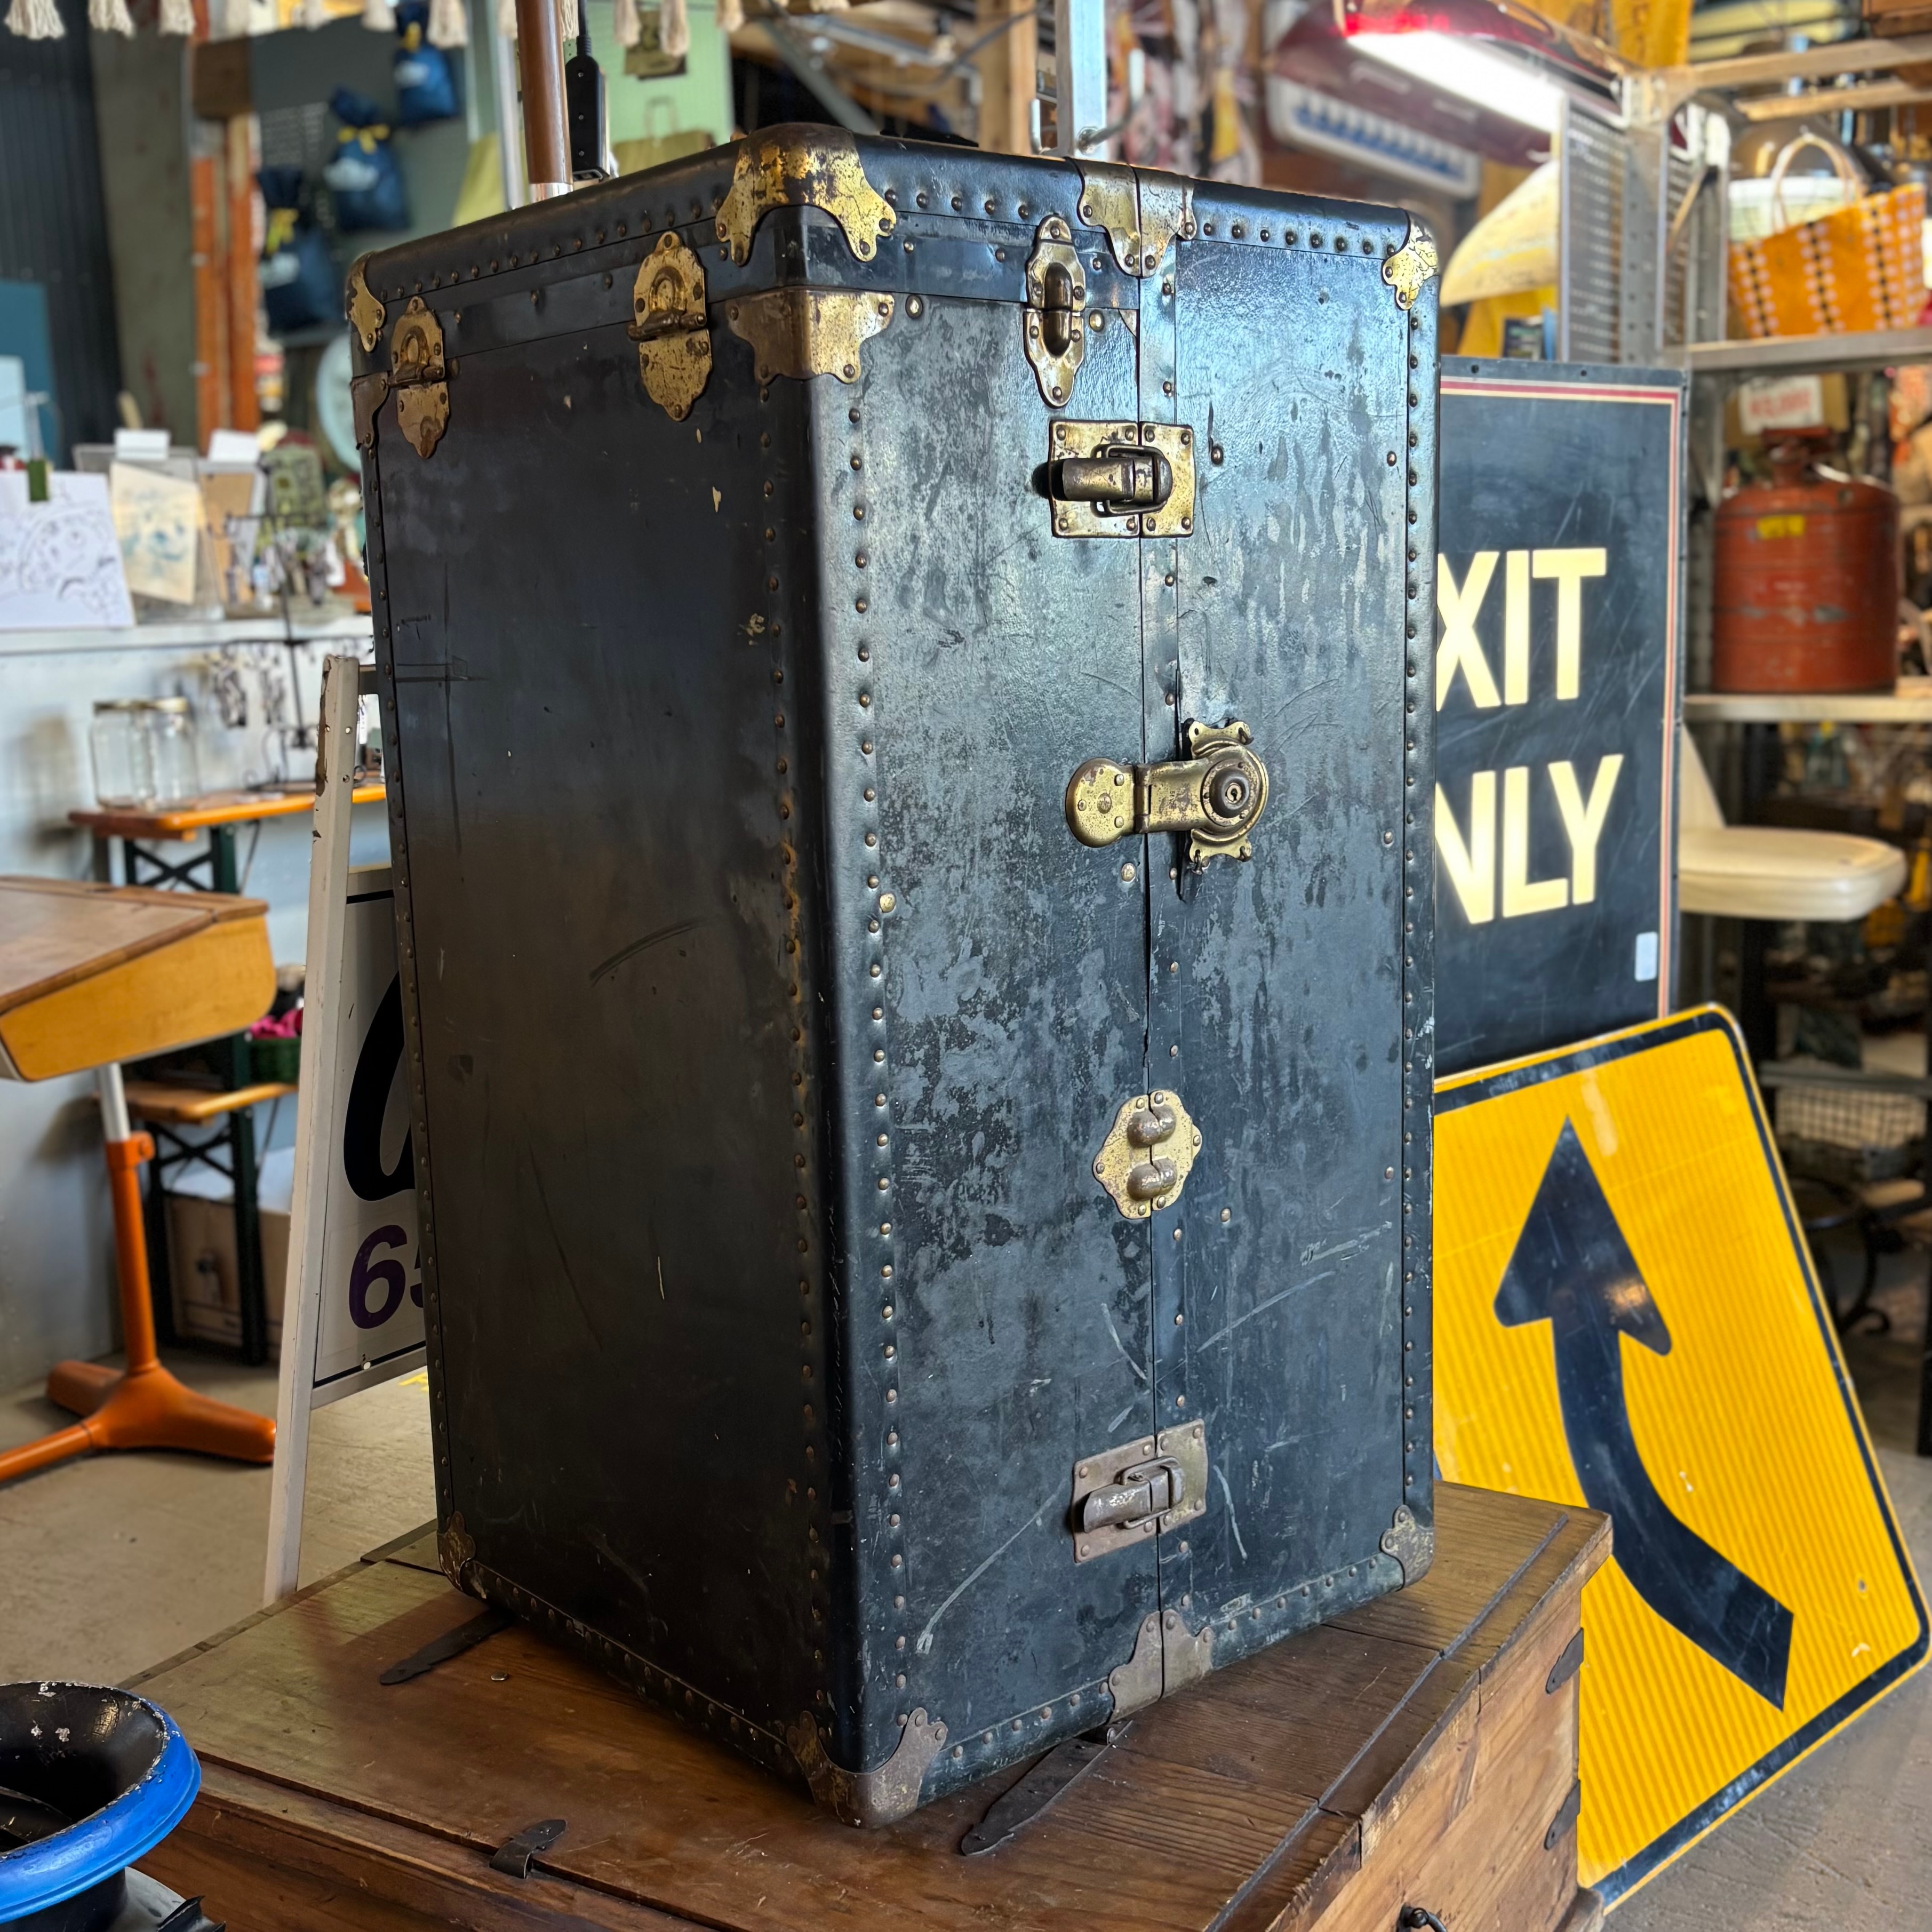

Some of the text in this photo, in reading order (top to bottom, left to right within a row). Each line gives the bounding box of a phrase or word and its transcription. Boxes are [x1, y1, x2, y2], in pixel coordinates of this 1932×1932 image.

[1436, 547, 1607, 713] XIT
[1433, 754, 1624, 924] NLY
[349, 1225, 423, 1329] 6
